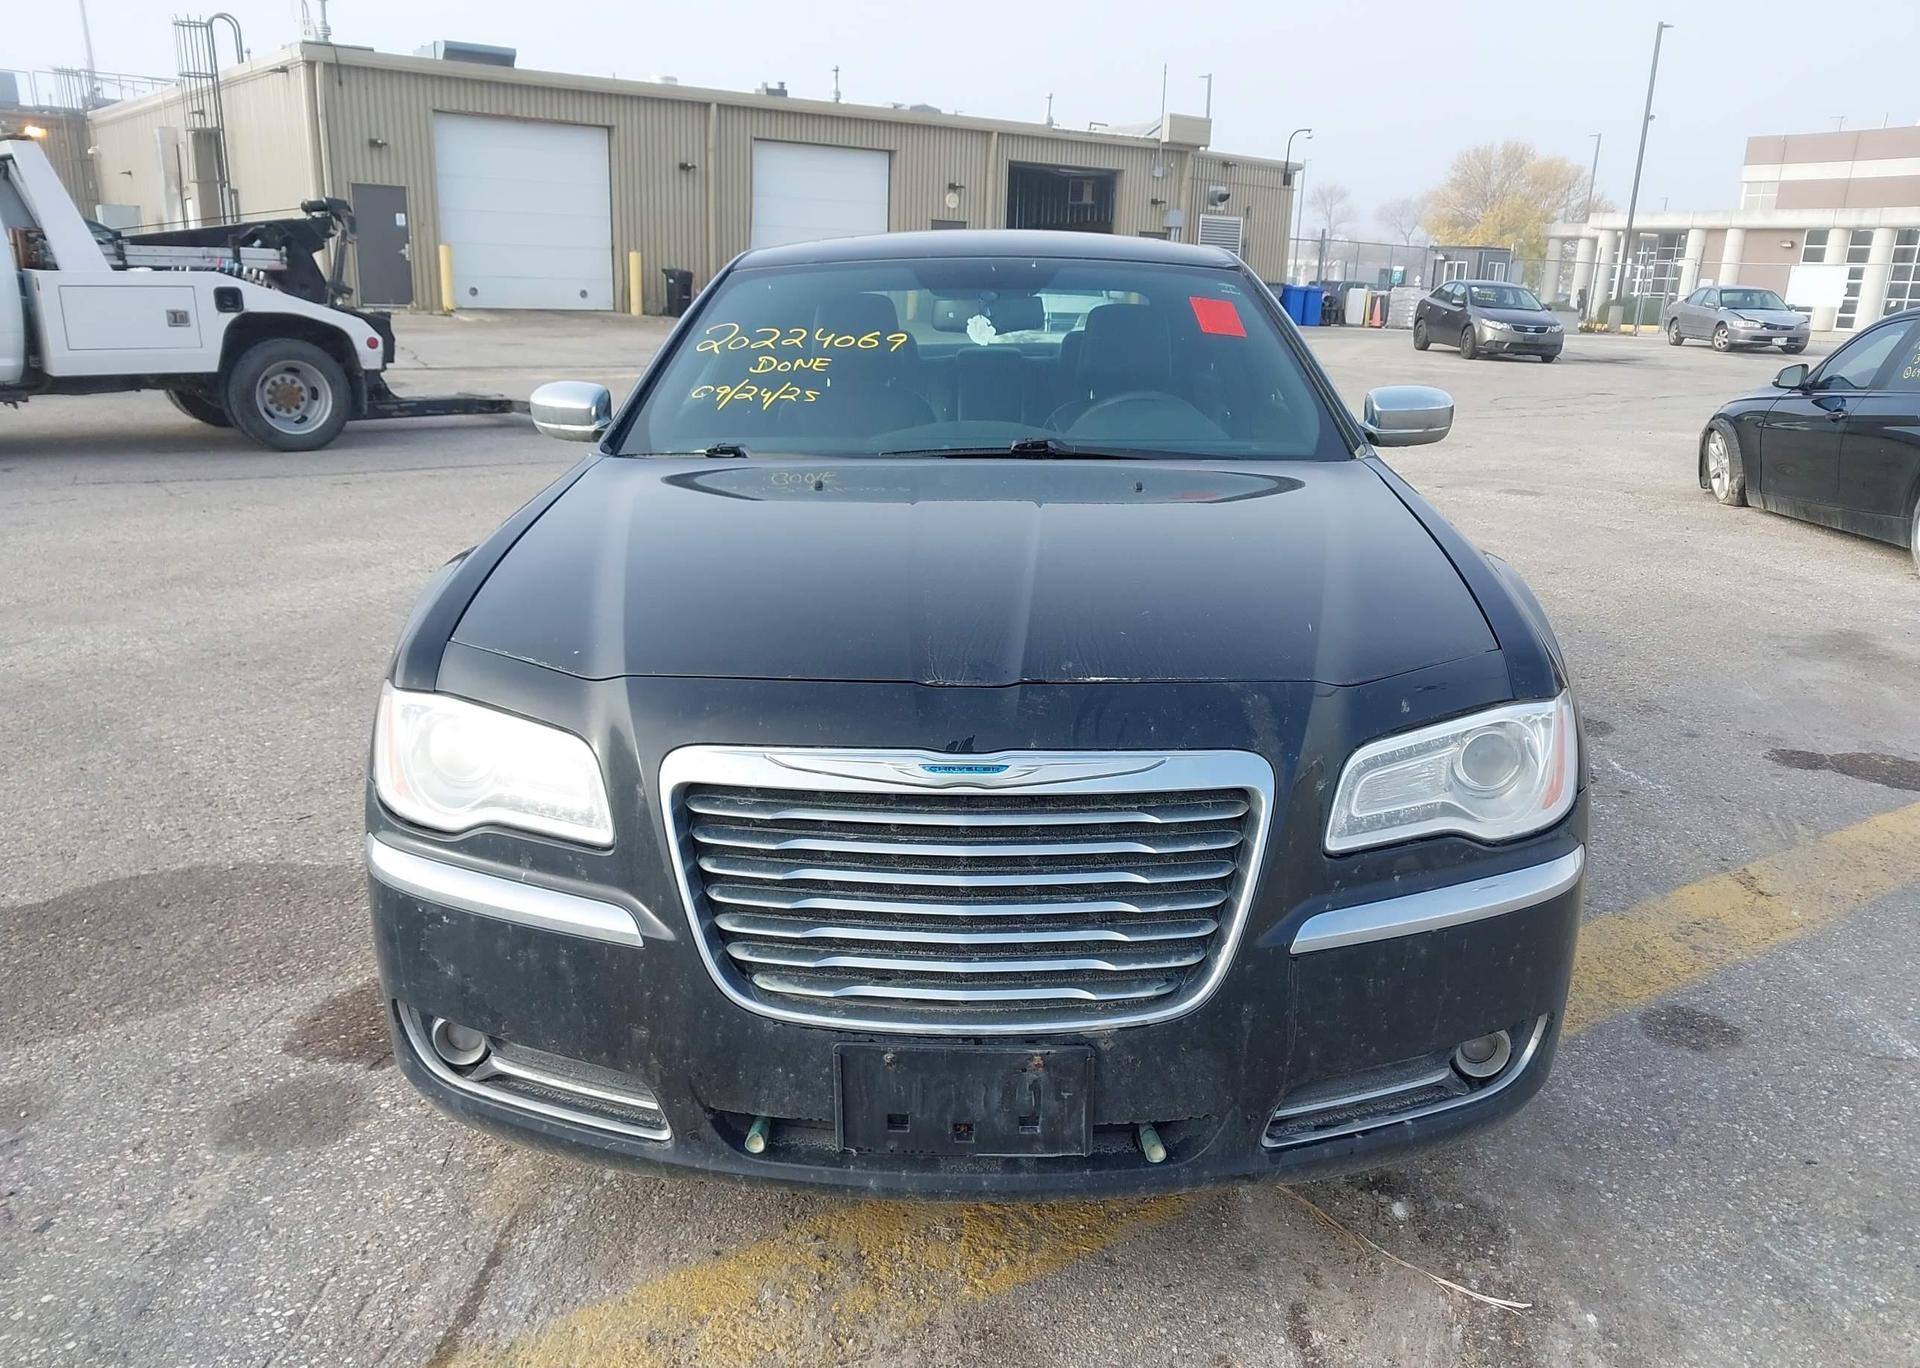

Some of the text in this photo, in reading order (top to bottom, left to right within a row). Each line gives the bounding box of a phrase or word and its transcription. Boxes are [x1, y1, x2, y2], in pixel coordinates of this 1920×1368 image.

[696, 322, 908, 354] 20224069
[691, 379, 820, 410] 09/24/25
[927, 765, 1003, 774] CHRYSLER
